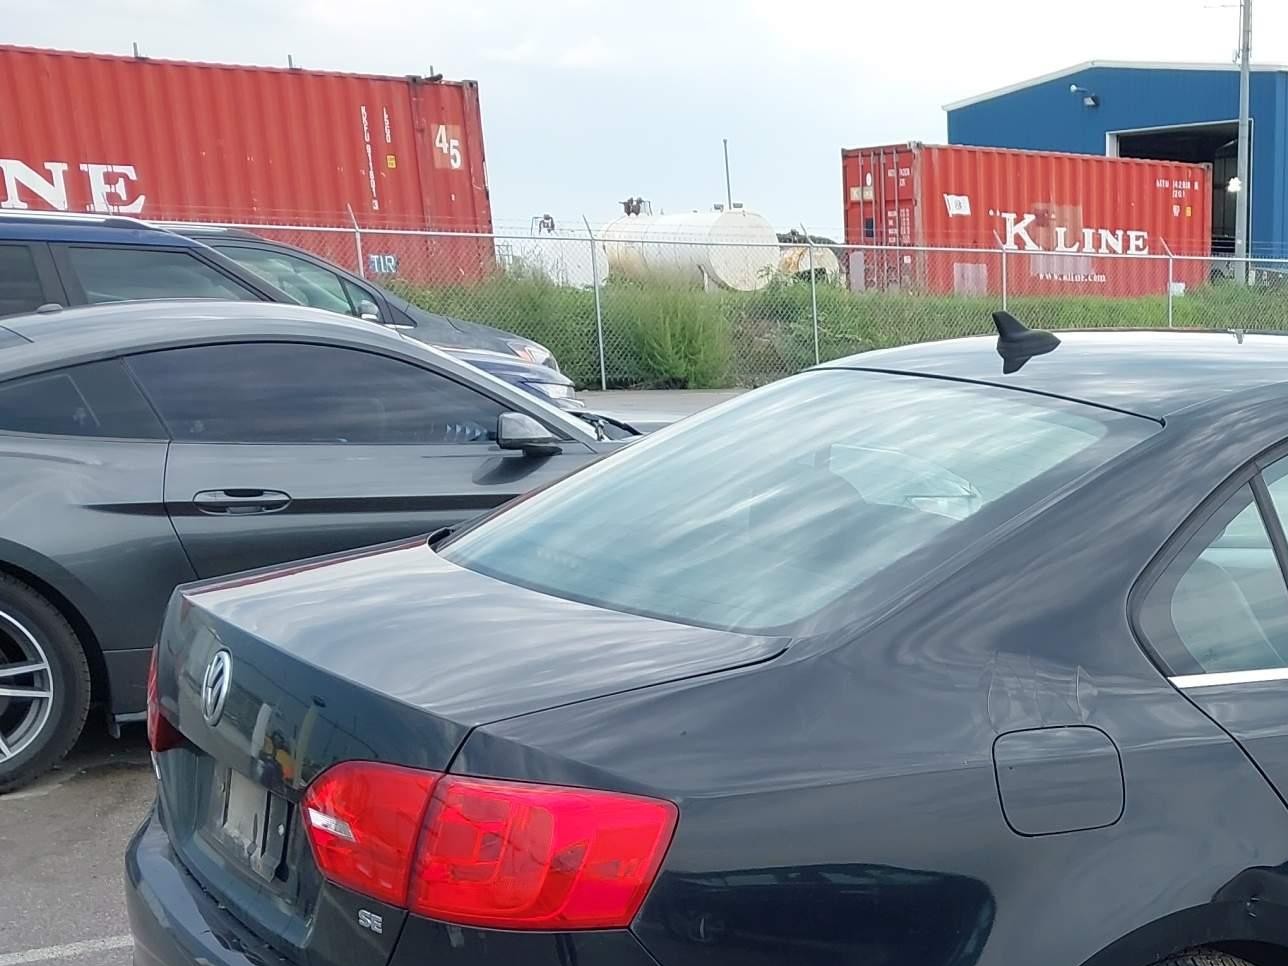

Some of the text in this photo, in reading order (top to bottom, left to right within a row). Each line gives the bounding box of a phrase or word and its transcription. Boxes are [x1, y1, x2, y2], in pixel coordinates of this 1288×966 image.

[436, 124, 461, 169] 45
[1055, 227, 1149, 254] LINE
[370, 255, 395, 273] TIR
[358, 909, 383, 934] SE
